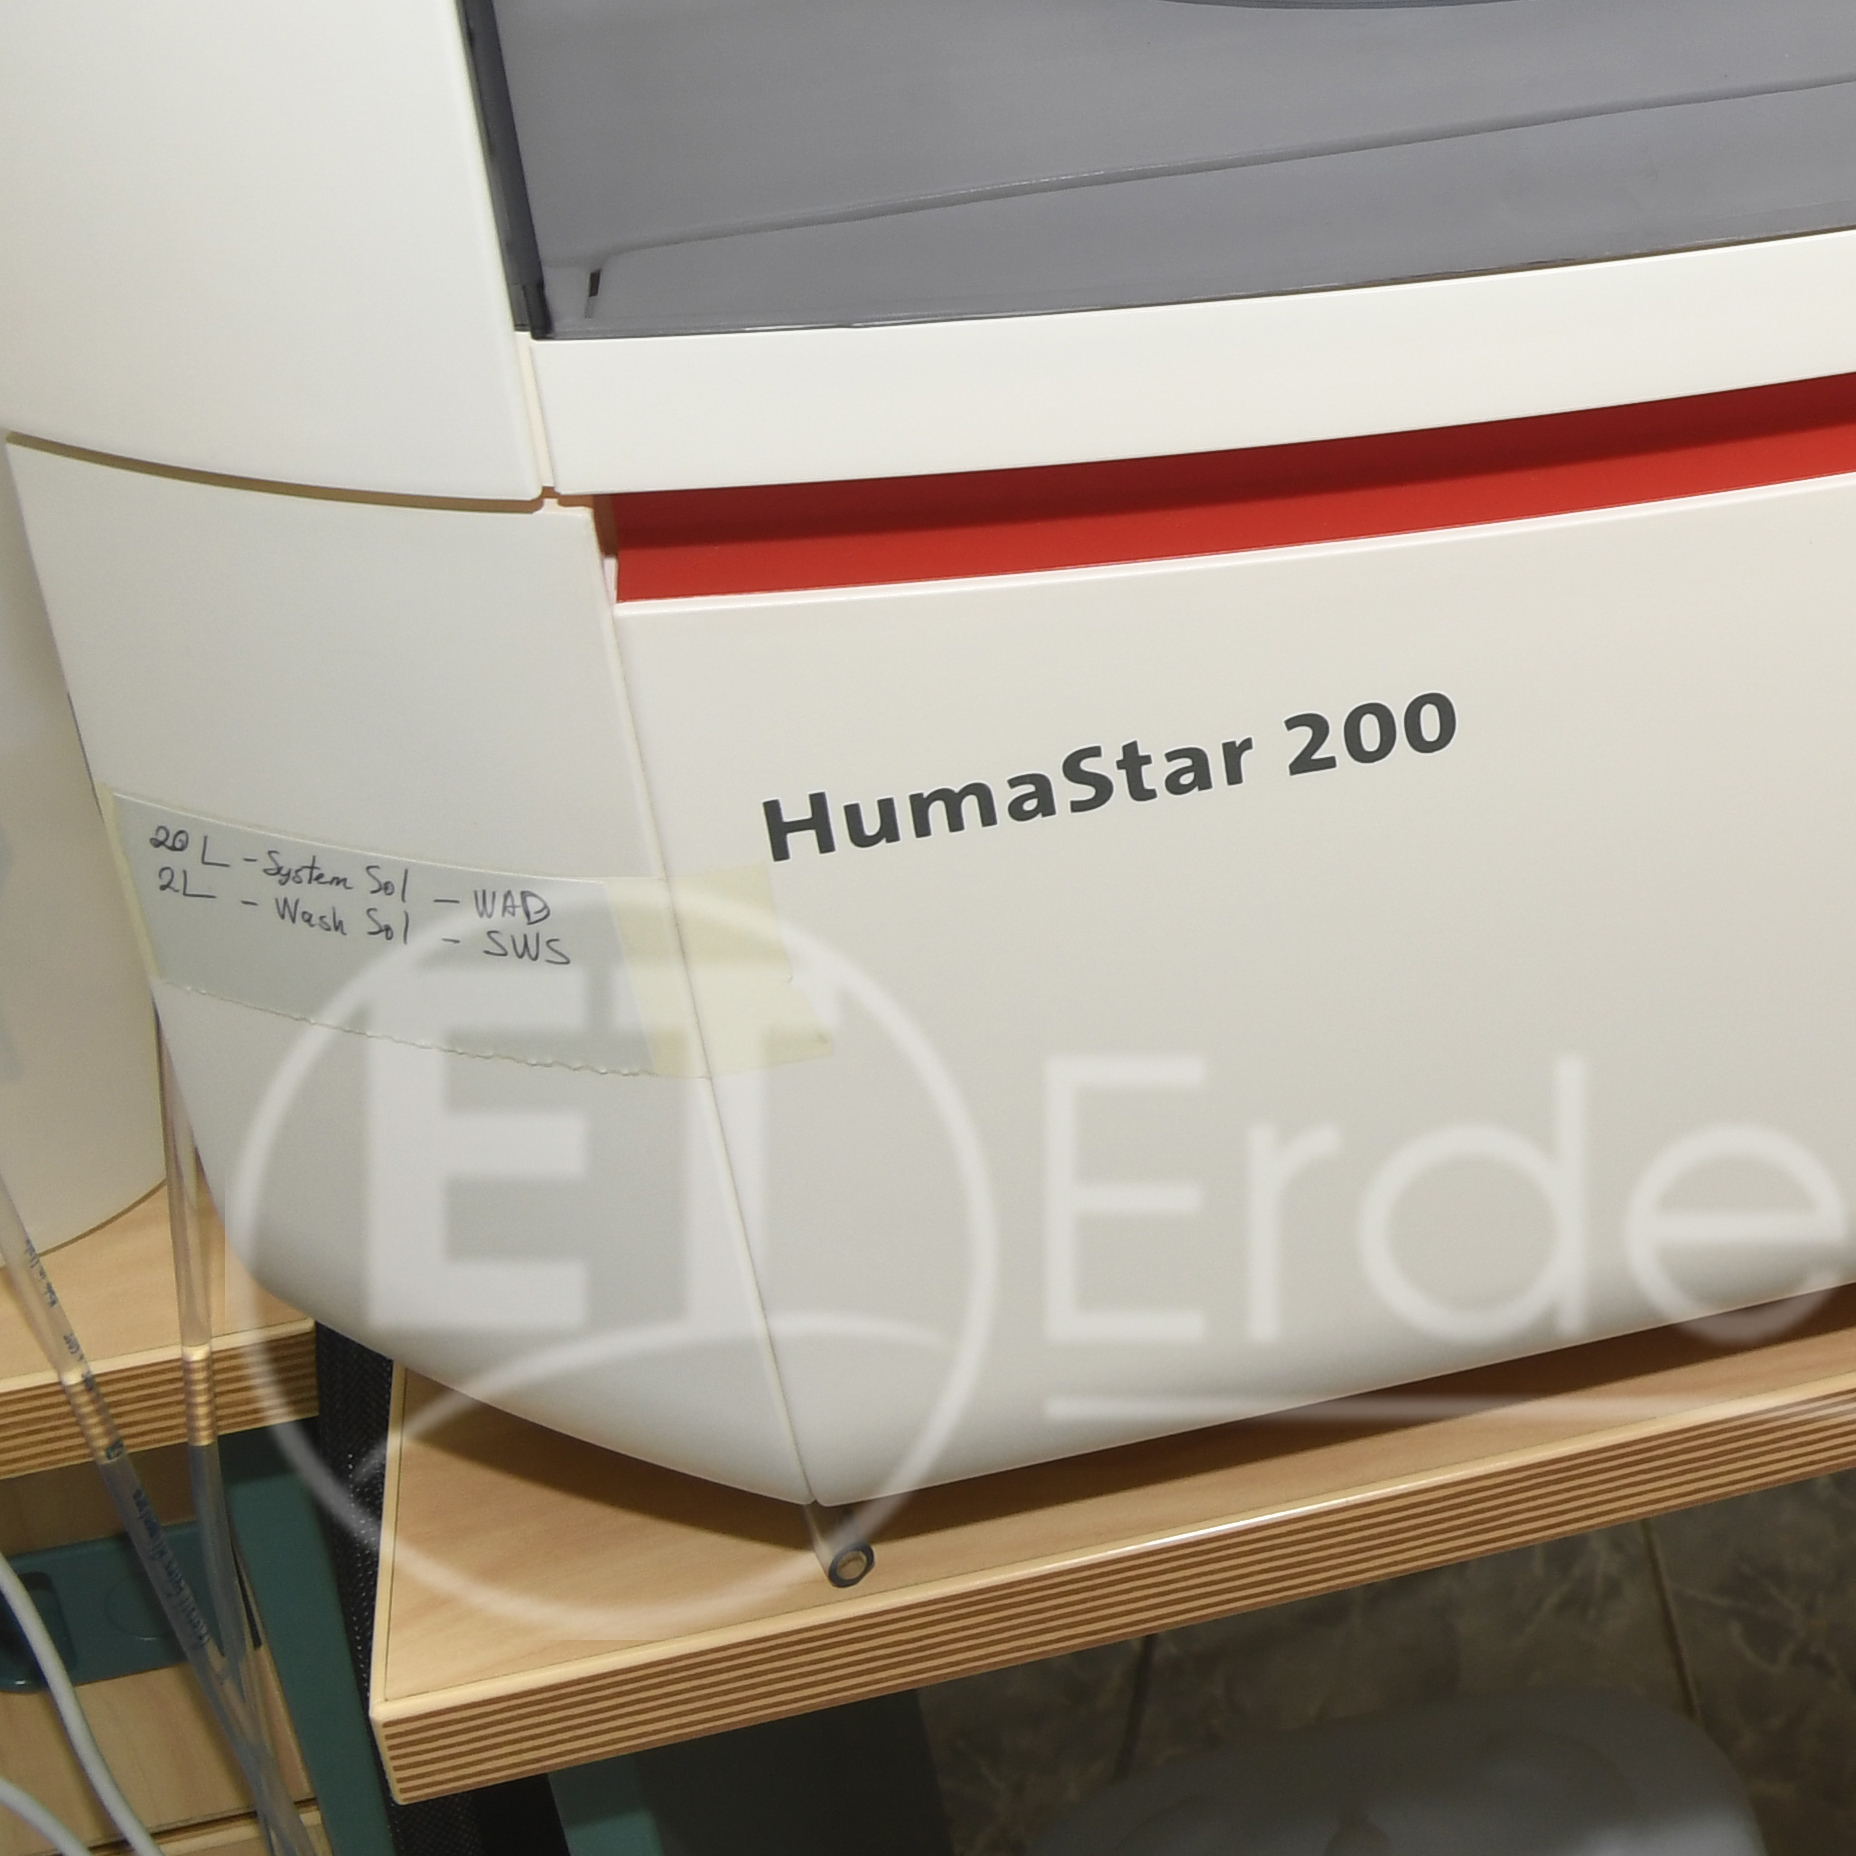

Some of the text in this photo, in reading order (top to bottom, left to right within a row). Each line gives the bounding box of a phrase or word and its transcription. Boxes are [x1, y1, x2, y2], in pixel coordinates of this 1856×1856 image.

[761, 691, 1458, 863] HumaStar 200
[365, 864, 409, 904] Sol
[275, 896, 348, 937] Wash
[365, 907, 410, 945] Sol
[482, 929, 572, 966] SWS
